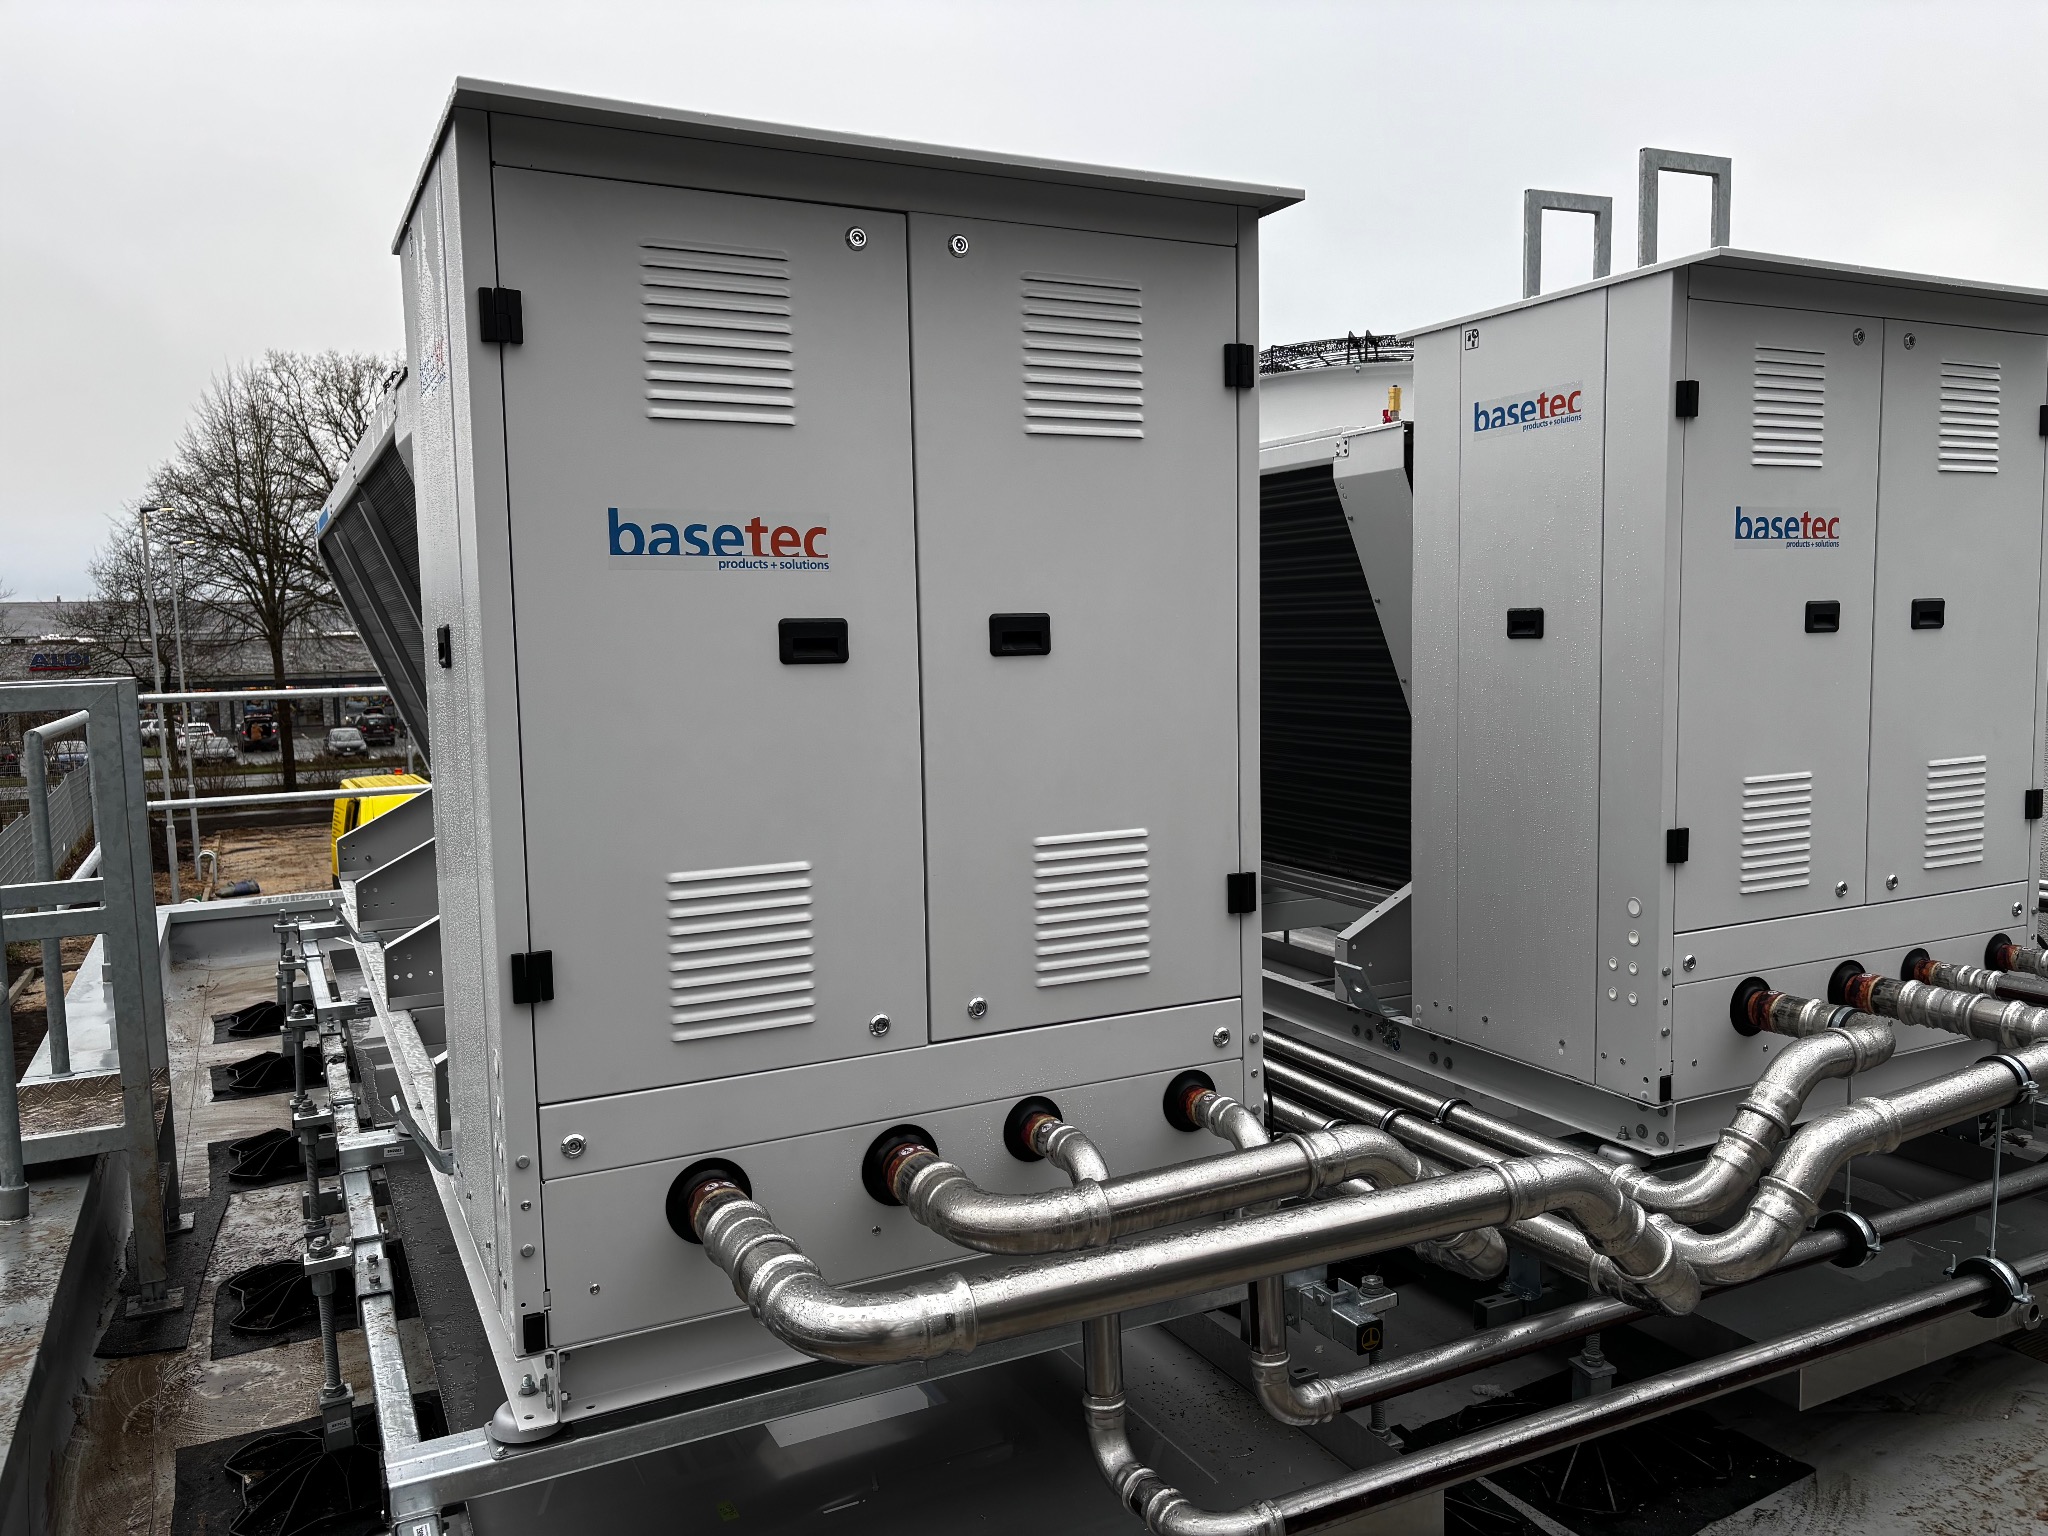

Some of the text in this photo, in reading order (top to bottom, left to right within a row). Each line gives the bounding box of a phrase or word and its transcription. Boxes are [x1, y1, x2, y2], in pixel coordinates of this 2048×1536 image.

[1474, 390, 1581, 432] basetec
[1522, 421, 1548, 432] products
[1554, 415, 1582, 425] solutions
[1735, 506, 1839, 539] basetec
[608, 507, 829, 558] basetec
[1786, 540, 1810, 549] products
[1814, 540, 1839, 548] solutions
[719, 558, 829, 570] products + solutions
[30, 653, 91, 667] ALDI
